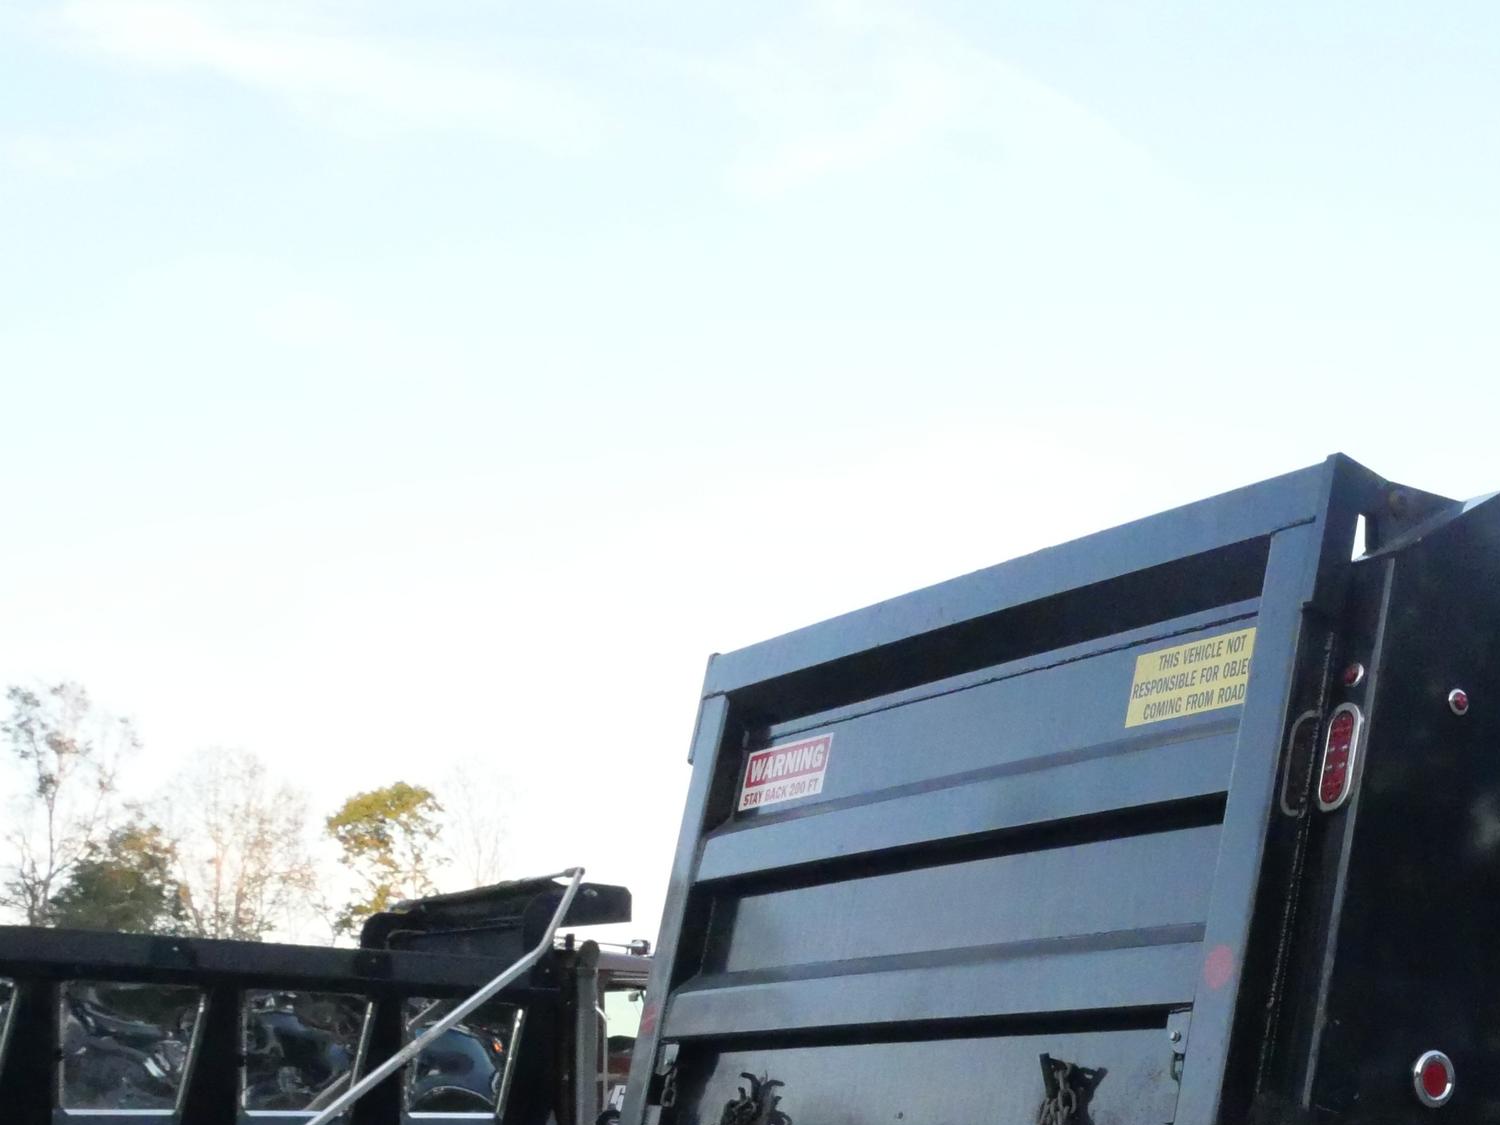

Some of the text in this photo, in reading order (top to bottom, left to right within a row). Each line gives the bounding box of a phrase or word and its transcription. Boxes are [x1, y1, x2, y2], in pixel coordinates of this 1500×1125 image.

[1159, 635, 1247, 671] THIS VEHICLE NOT
[1132, 658, 1249, 699] RESPONSIBLE FOR OBJE
[1143, 684, 1245, 720] COMING FROM ROAD
[750, 743, 825, 783] WARNING
[743, 790, 765, 806] STAY
[765, 785, 787, 801] BACK
[808, 778, 819, 793] FT
